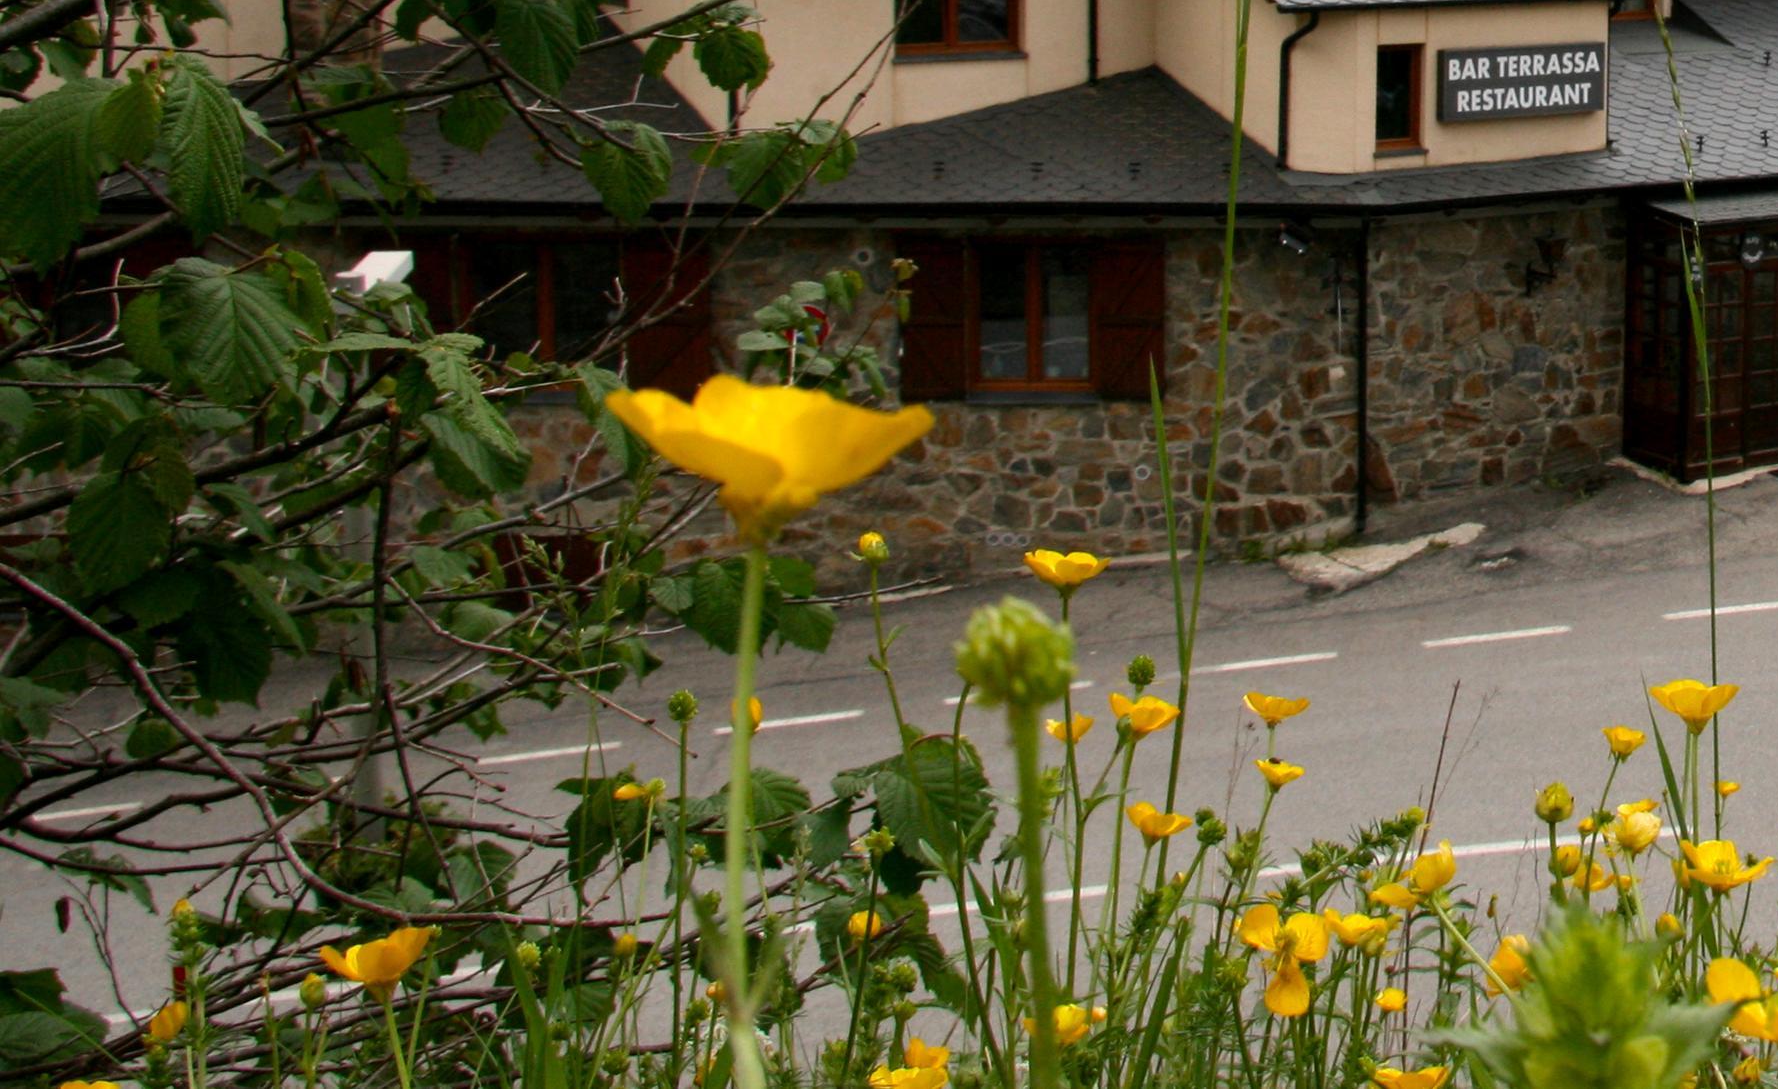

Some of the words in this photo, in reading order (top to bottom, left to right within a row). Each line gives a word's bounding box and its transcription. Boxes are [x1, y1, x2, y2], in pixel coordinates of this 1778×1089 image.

[1448, 57, 1491, 81] BAR
[1496, 51, 1601, 78] TERRASSA
[1457, 82, 1592, 113] RESTAURANT
